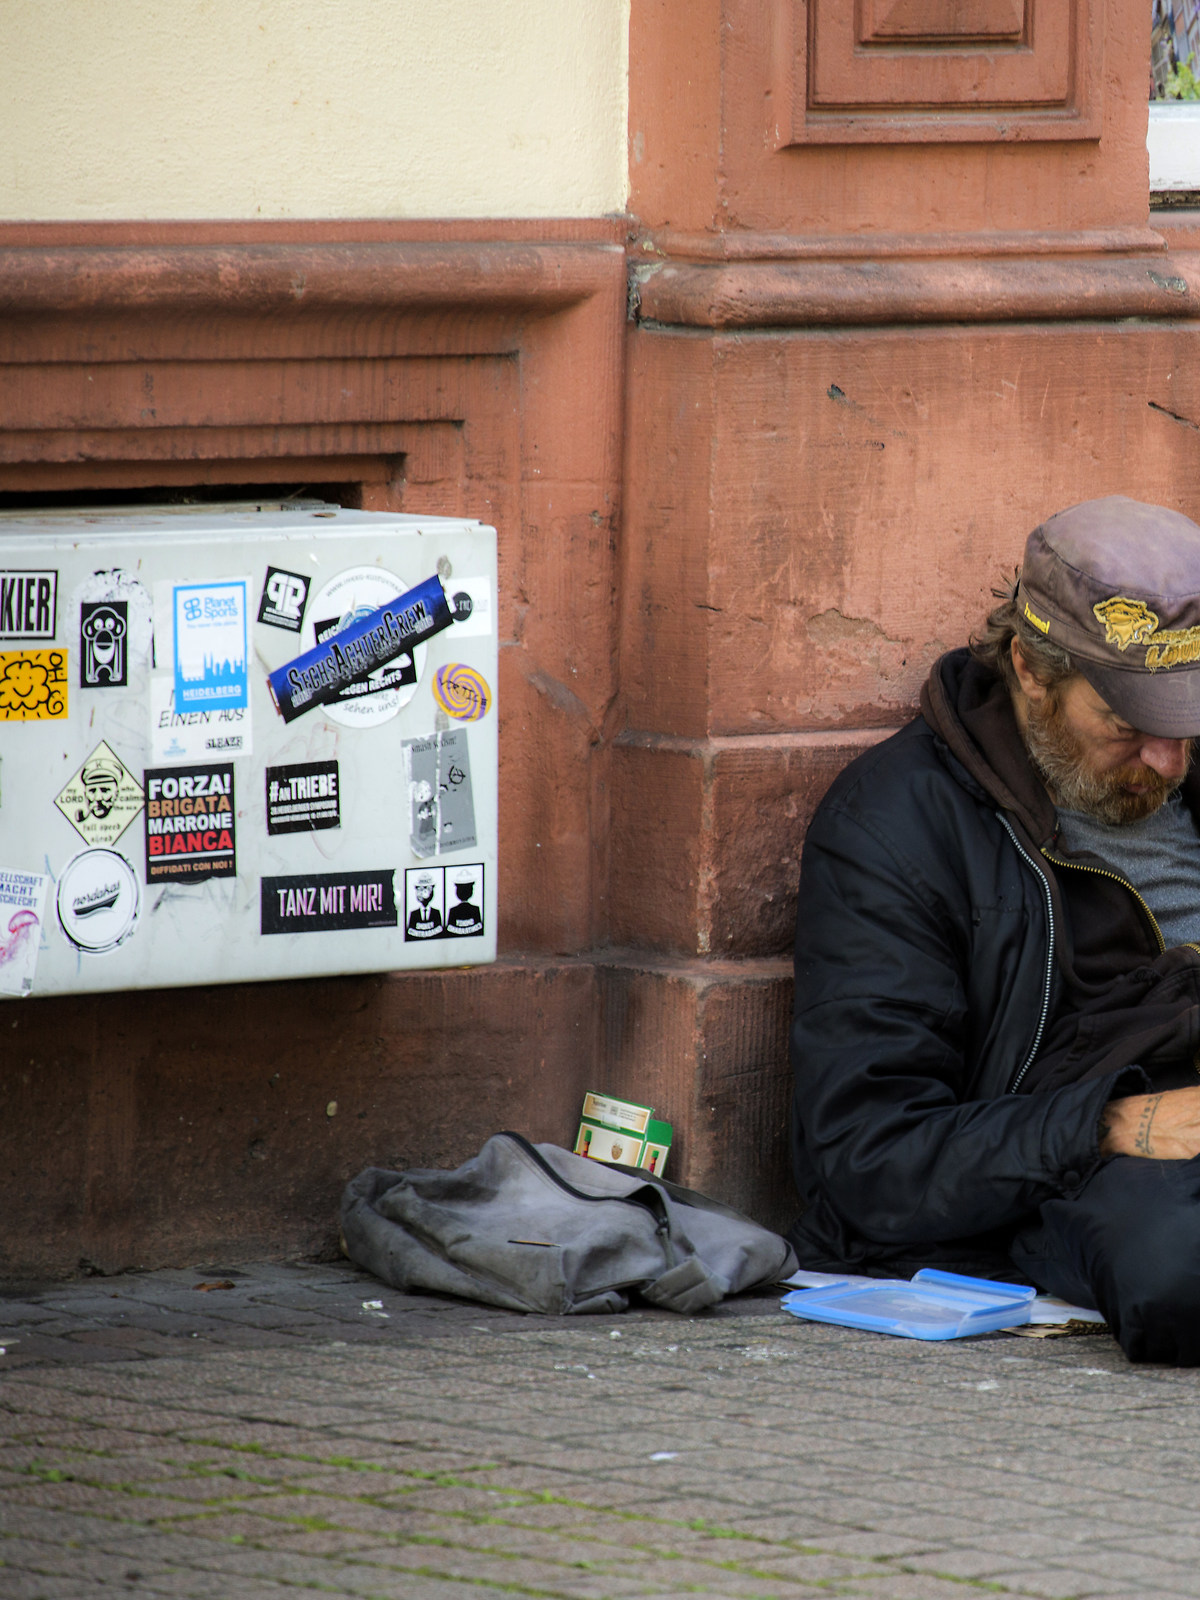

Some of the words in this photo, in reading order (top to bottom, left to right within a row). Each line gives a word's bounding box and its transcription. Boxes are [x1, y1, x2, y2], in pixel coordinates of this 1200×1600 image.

[204, 597, 236, 608] Planet
[205, 607, 238, 619] Sports
[183, 686, 242, 699] HEIDELBERG
[149, 774, 231, 800] FORZA!
[148, 796, 231, 819] BRIGATA
[149, 813, 232, 835] MARRONE
[149, 830, 233, 856] BIANCA
[150, 864, 191, 875] DIFFIDATI
[193, 862, 211, 871] CON
[213, 861, 227, 870] NOI
[277, 889, 317, 918] TANZ
[320, 886, 347, 914] MIT
[350, 884, 383, 913] MIR!
